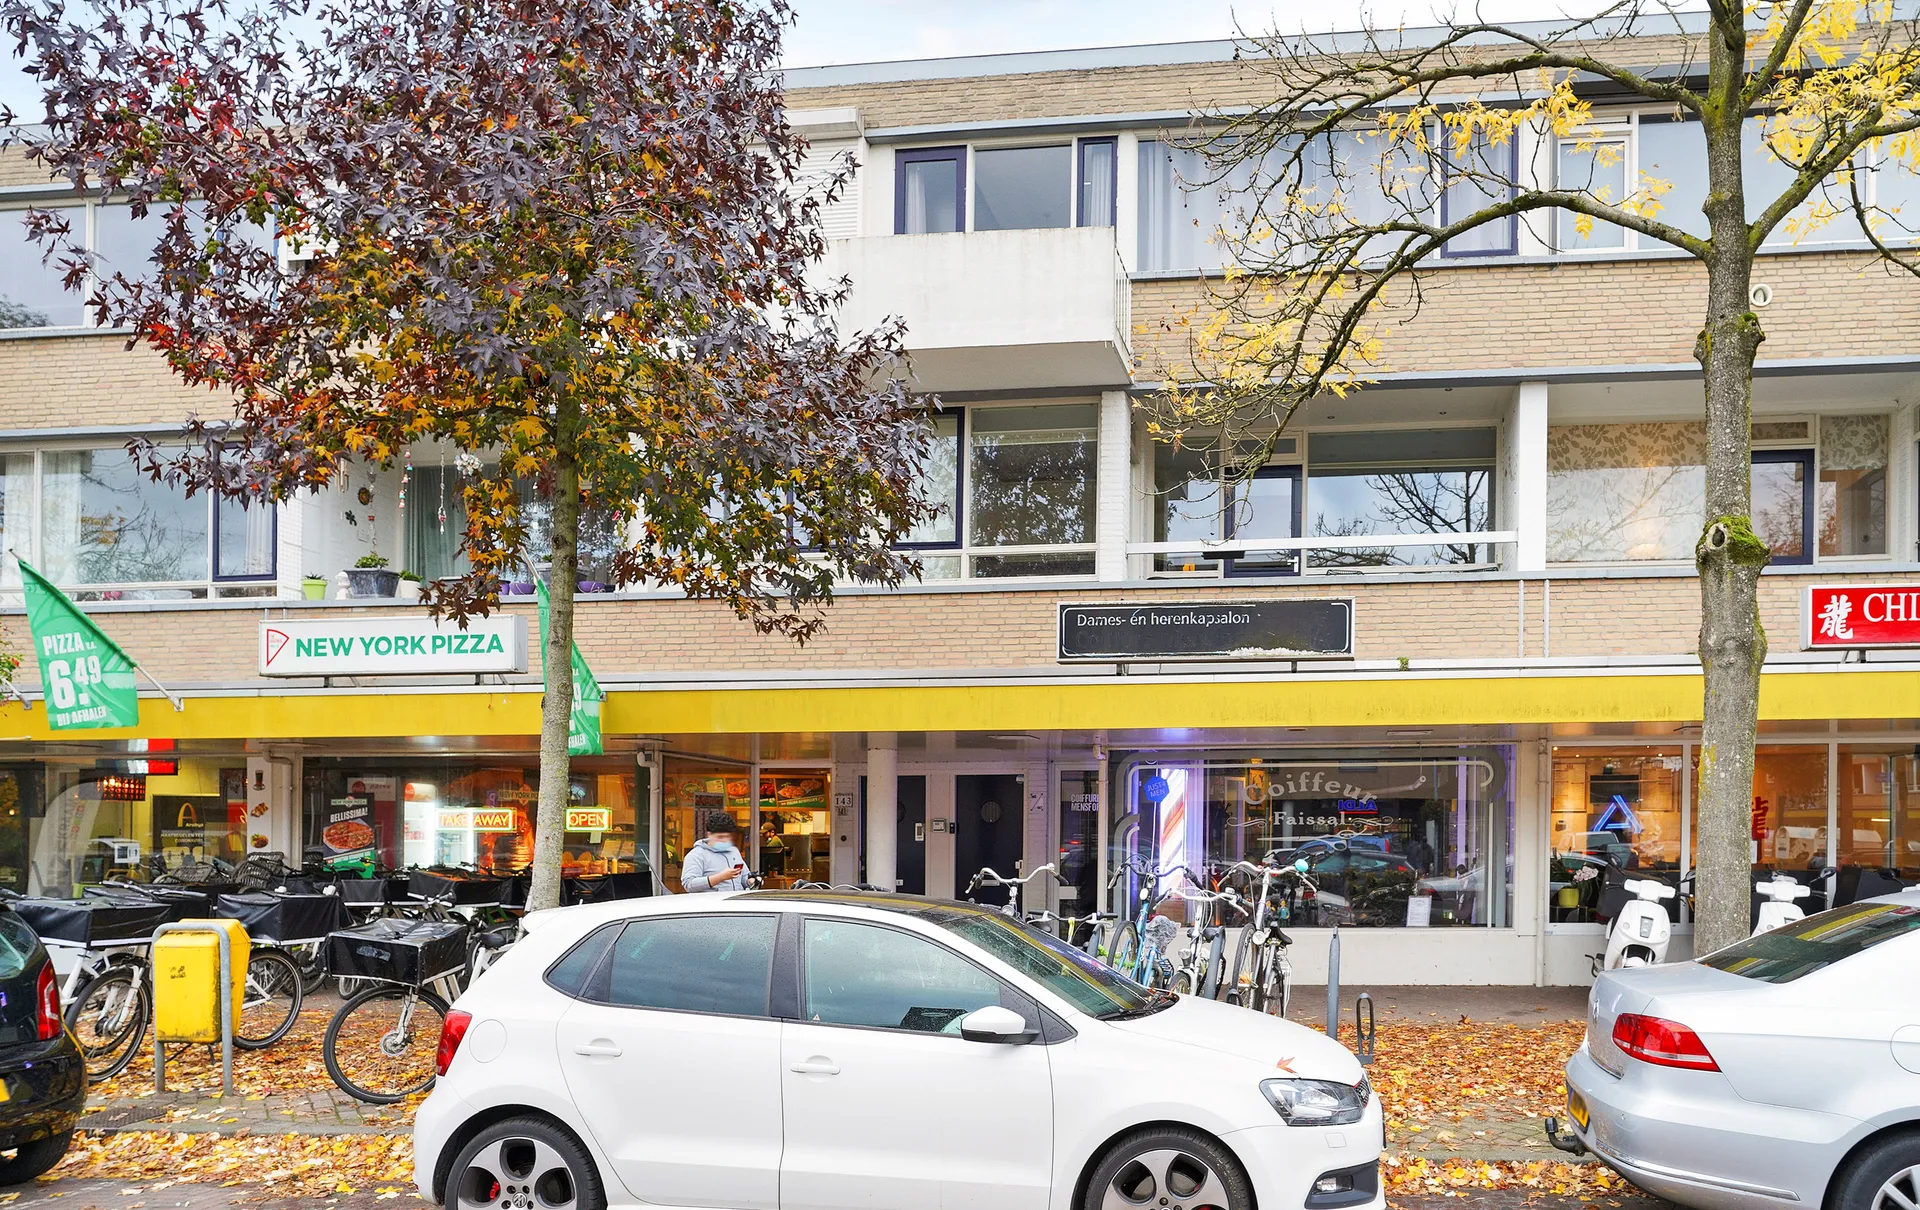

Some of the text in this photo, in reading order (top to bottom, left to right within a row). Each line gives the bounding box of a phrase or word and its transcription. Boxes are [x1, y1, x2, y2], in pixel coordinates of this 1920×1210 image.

[1077, 614, 1126, 627] Dames-
[1151, 611, 1250, 627] herenkapsalon
[1817, 594, 1854, 640] 龍
[42, 632, 85, 656] PIZZA
[296, 637, 354, 657] NEW
[360, 635, 427, 656] YORK
[432, 633, 504, 654] PIZZA
[56, 705, 107, 727] BIJ AFHALEN
[1242, 771, 1378, 805] Coiffeur
[836, 797, 851, 805] 143
[330, 807, 368, 823] BELLISSIMA!
[440, 814, 509, 826] TAKE AWAY
[569, 813, 605, 826] OPEN
[1273, 811, 1346, 826] Faissal
